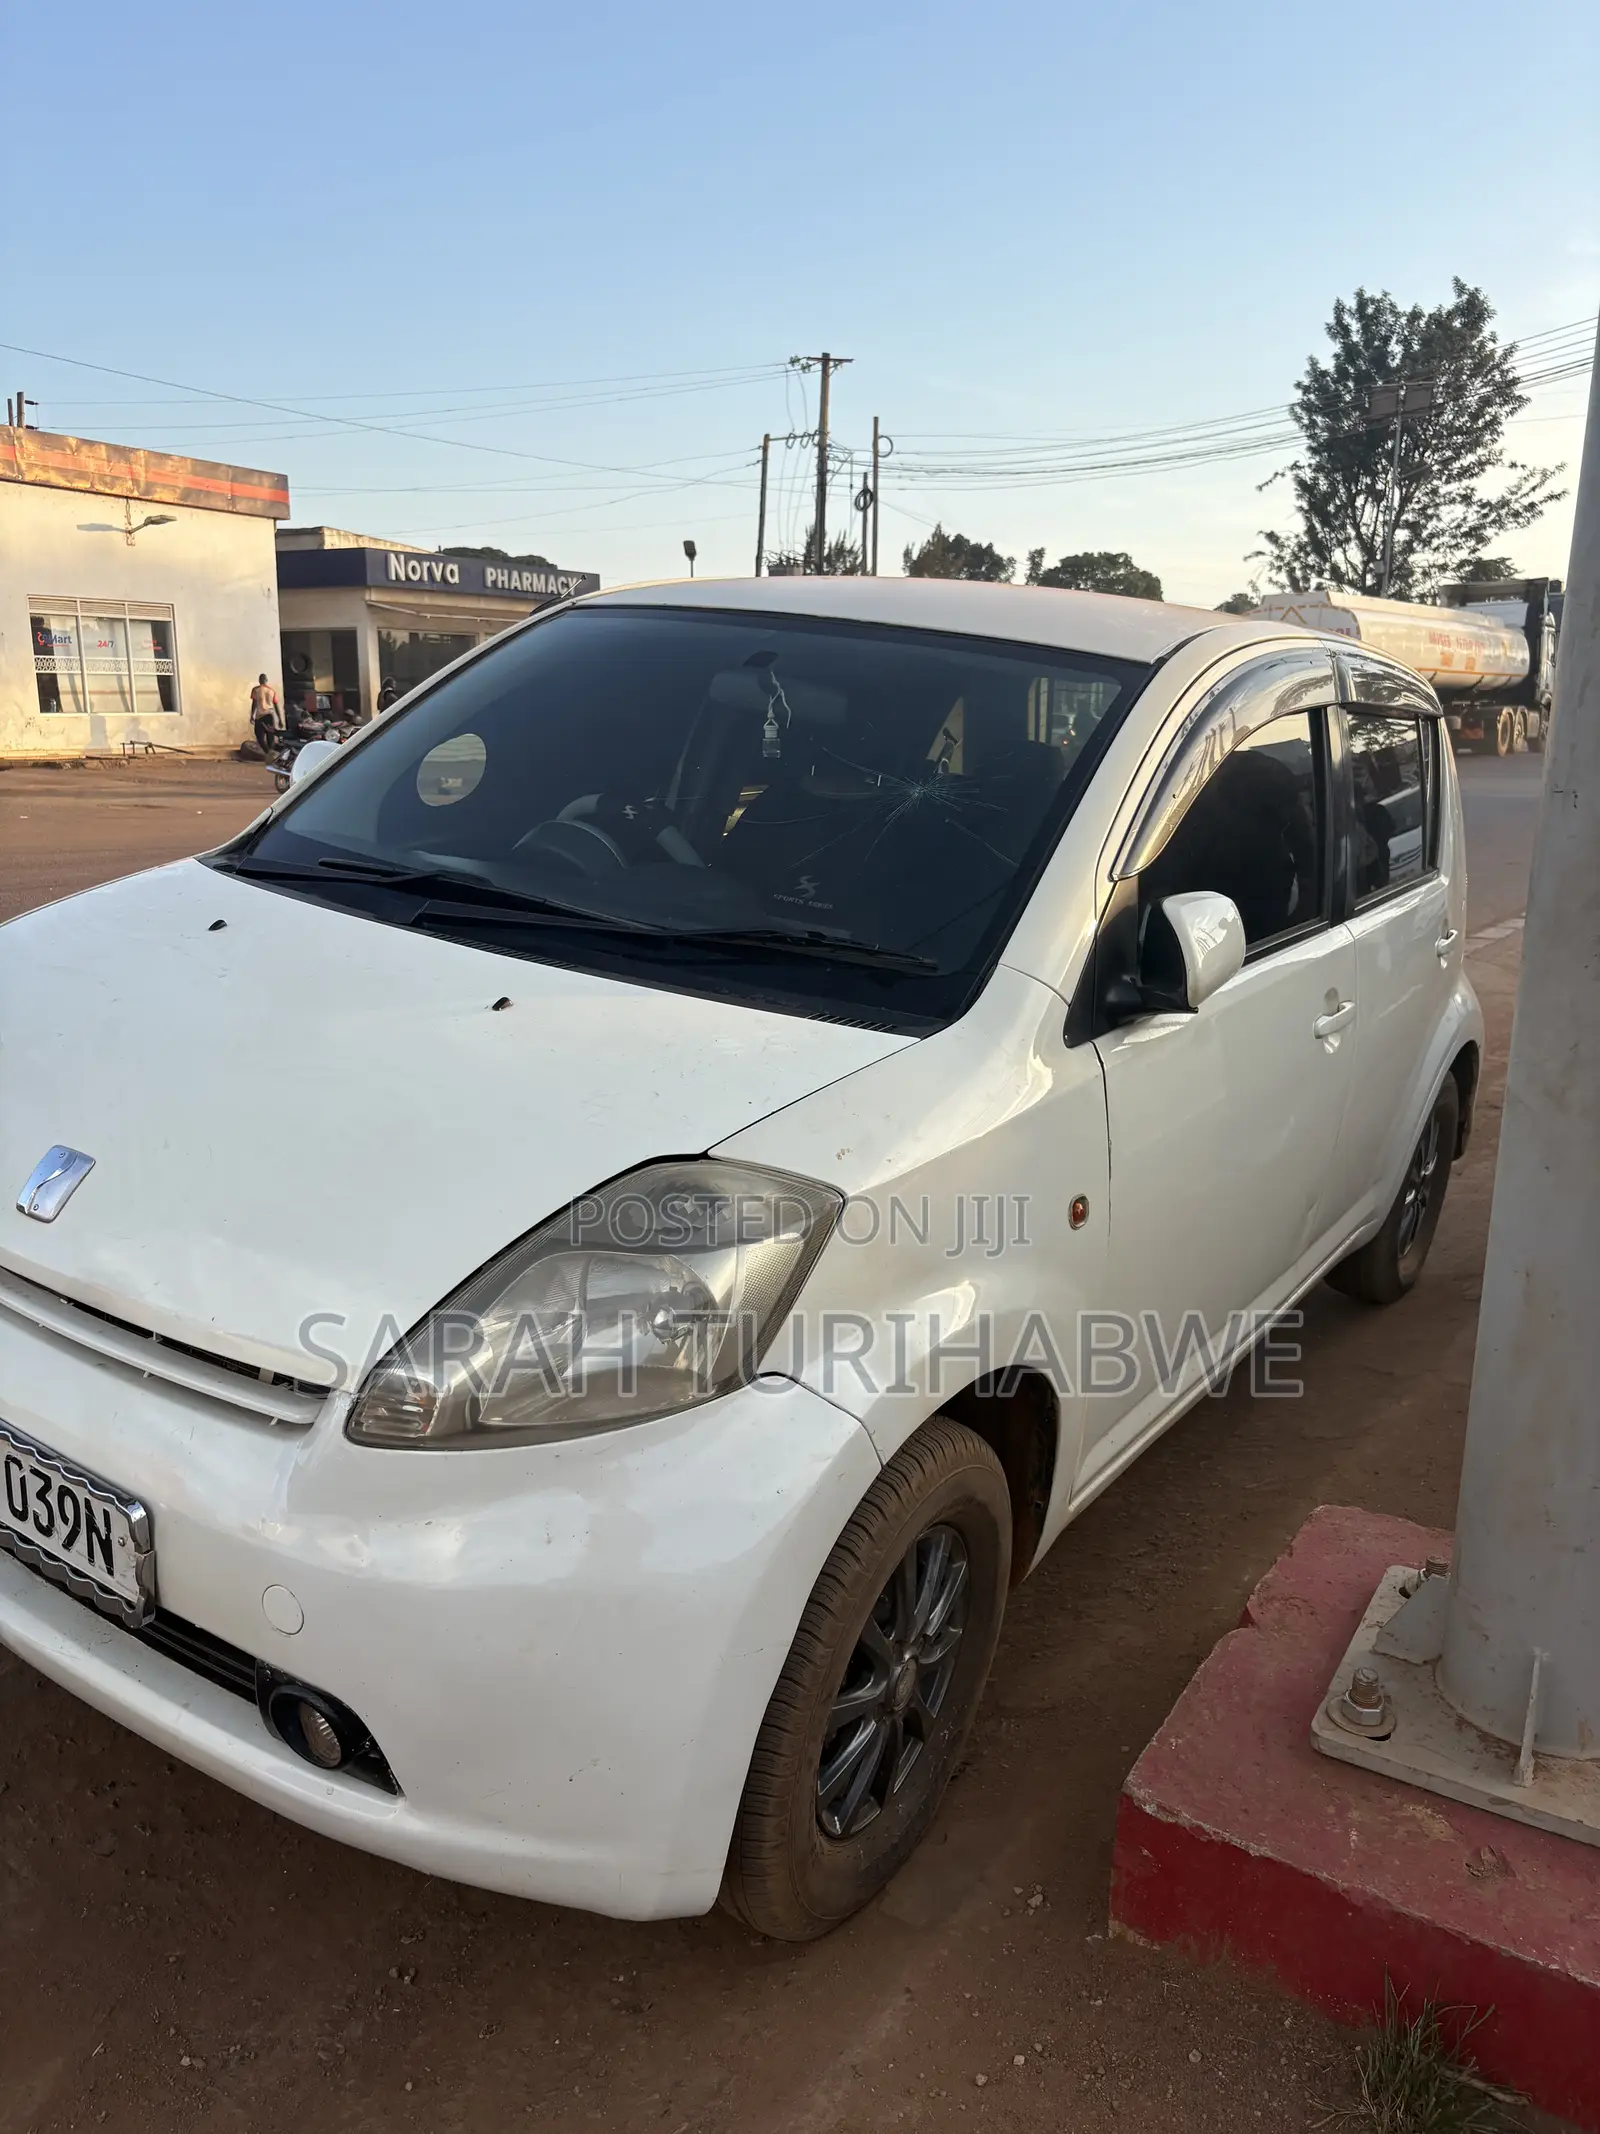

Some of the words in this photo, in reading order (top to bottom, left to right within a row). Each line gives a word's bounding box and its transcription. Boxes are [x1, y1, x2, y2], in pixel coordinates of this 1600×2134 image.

[387, 553, 460, 584] Norva
[484, 567, 578, 595] PHARMACY
[97, 639, 115, 648] 24/7
[4, 1454, 115, 1577] 039N
